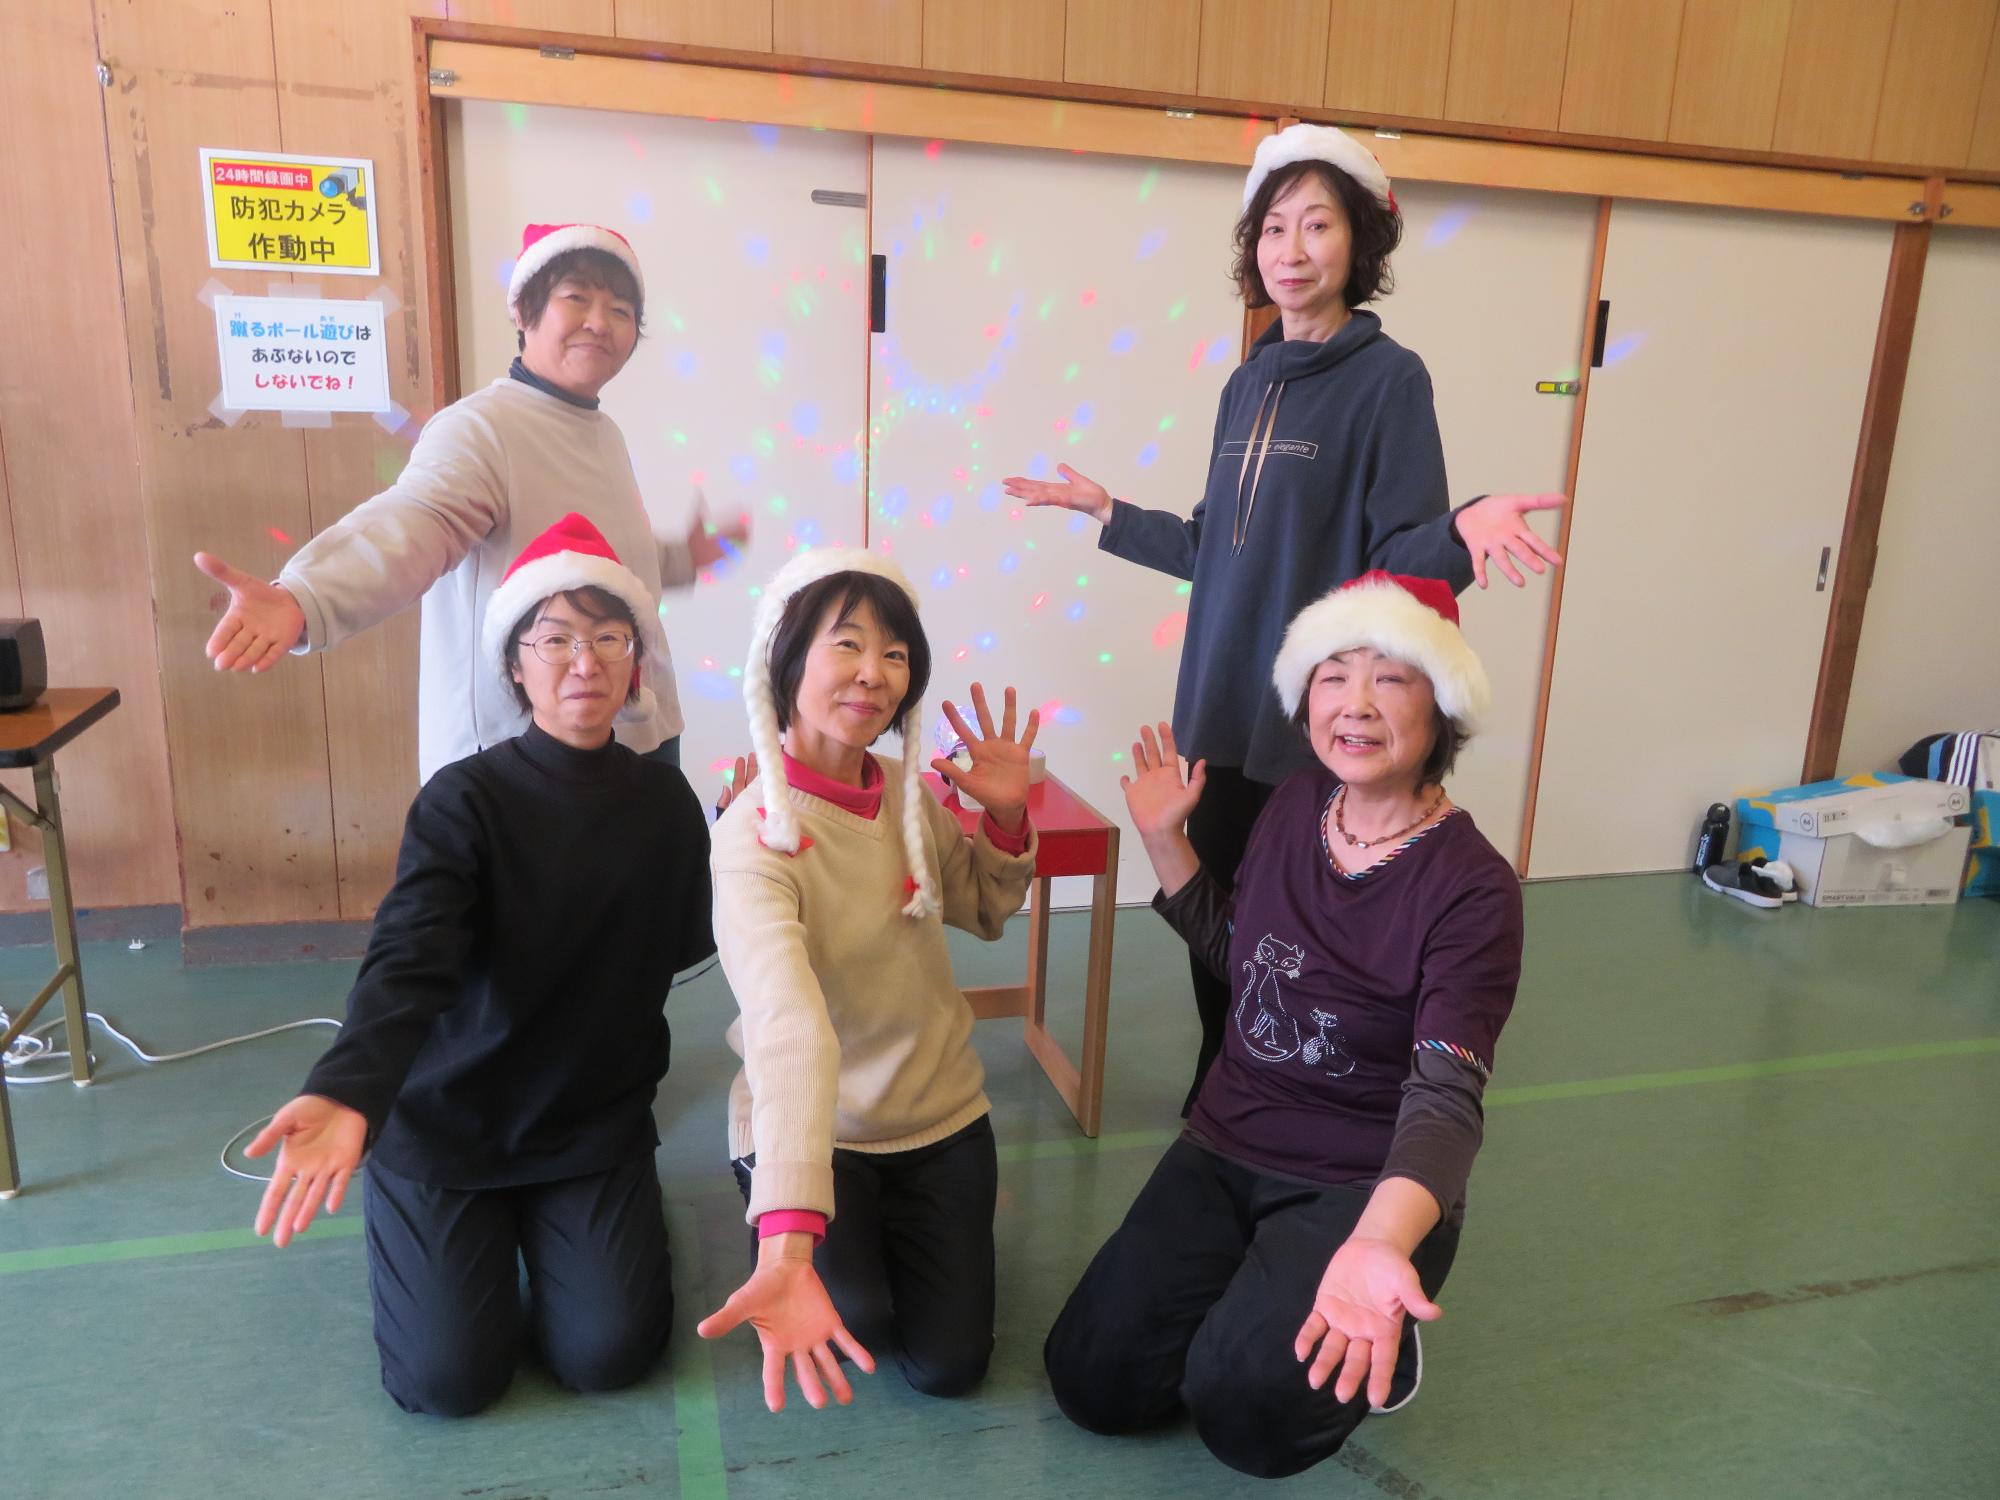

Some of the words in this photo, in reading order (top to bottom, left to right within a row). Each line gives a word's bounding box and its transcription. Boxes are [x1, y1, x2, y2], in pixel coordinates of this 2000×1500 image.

[215, 167, 309, 188] 24時間録画中
[231, 195, 347, 225] 防犯カメラ
[248, 232, 336, 263] 作動中
[230, 319, 372, 341] 蹴るボール遊びは
[251, 348, 357, 365] あぶないので
